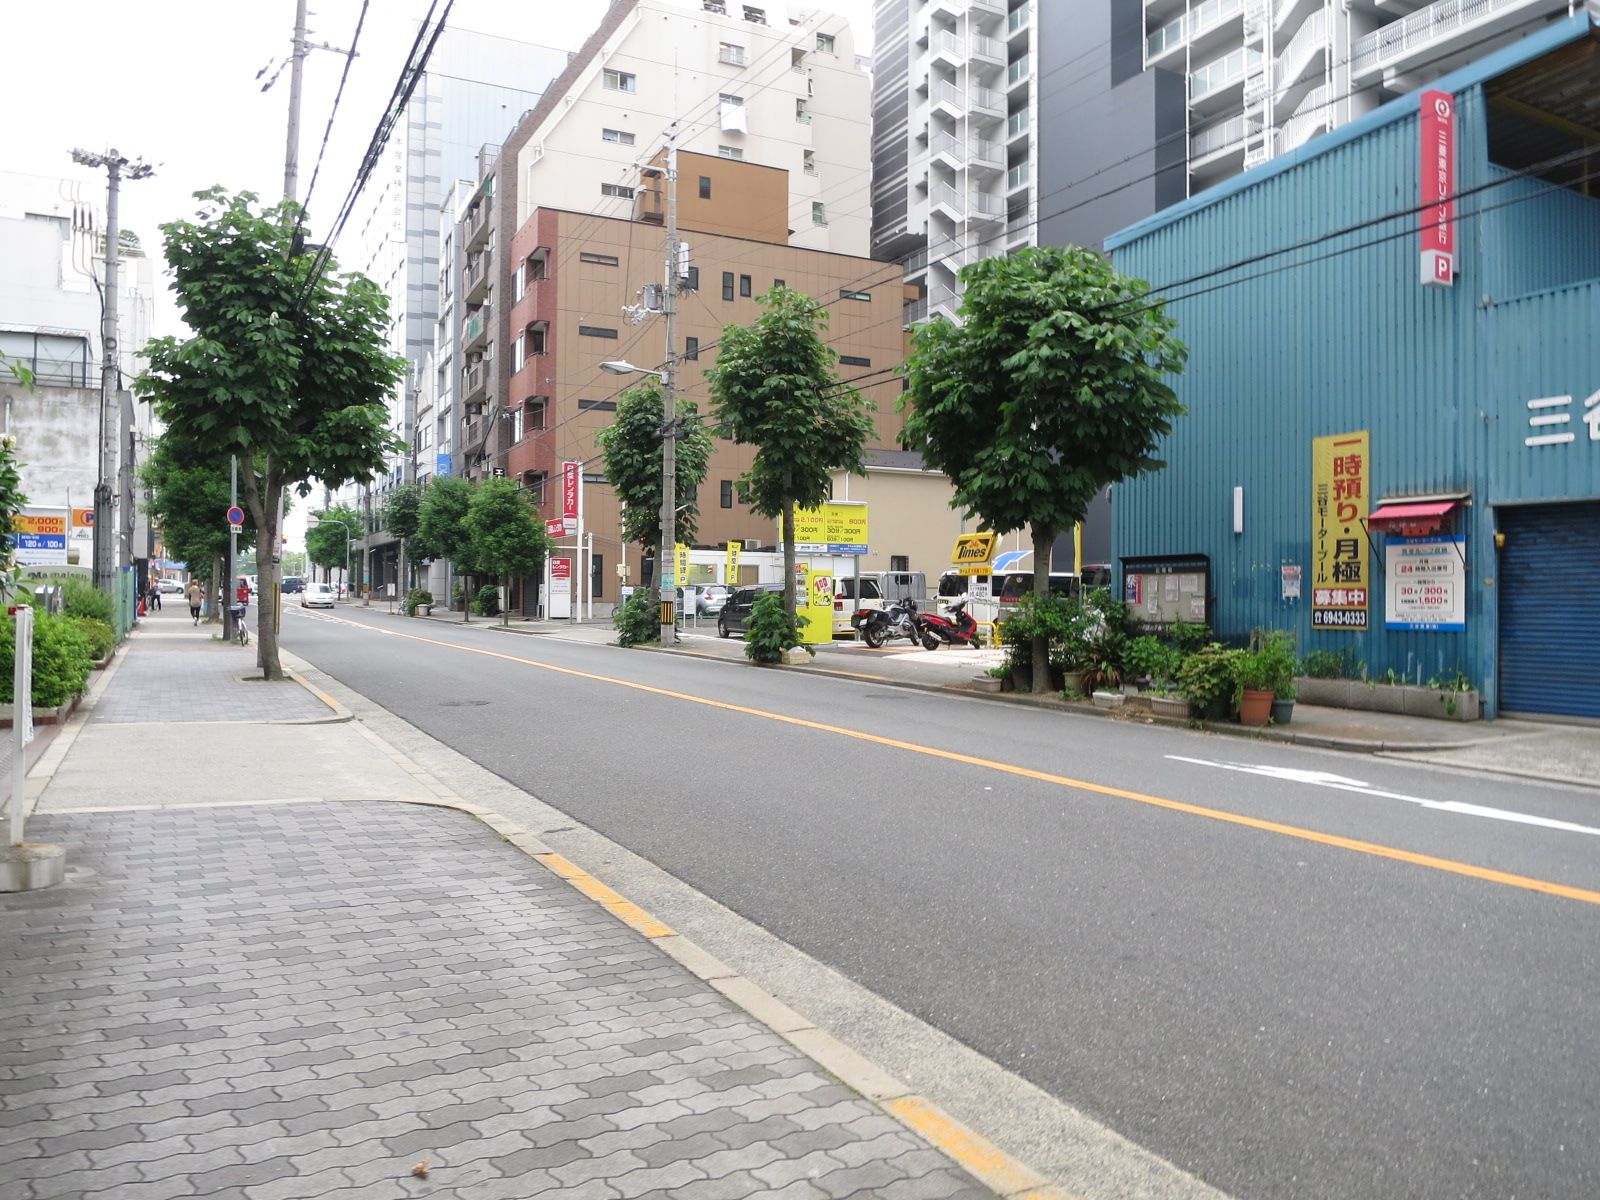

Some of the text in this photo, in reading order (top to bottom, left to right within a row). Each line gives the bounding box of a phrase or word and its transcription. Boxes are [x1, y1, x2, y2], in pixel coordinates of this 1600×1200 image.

[1438, 257, 1448, 277] P
[566, 465, 575, 511] 日産レンタカー
[1332, 438, 1362, 583] 一時預り・月極
[1317, 483, 1328, 583] 三谷モータープール
[958, 546, 987, 559] Times
[1315, 589, 1365, 605] 募集中
[1323, 610, 1366, 625] 6943-0333
